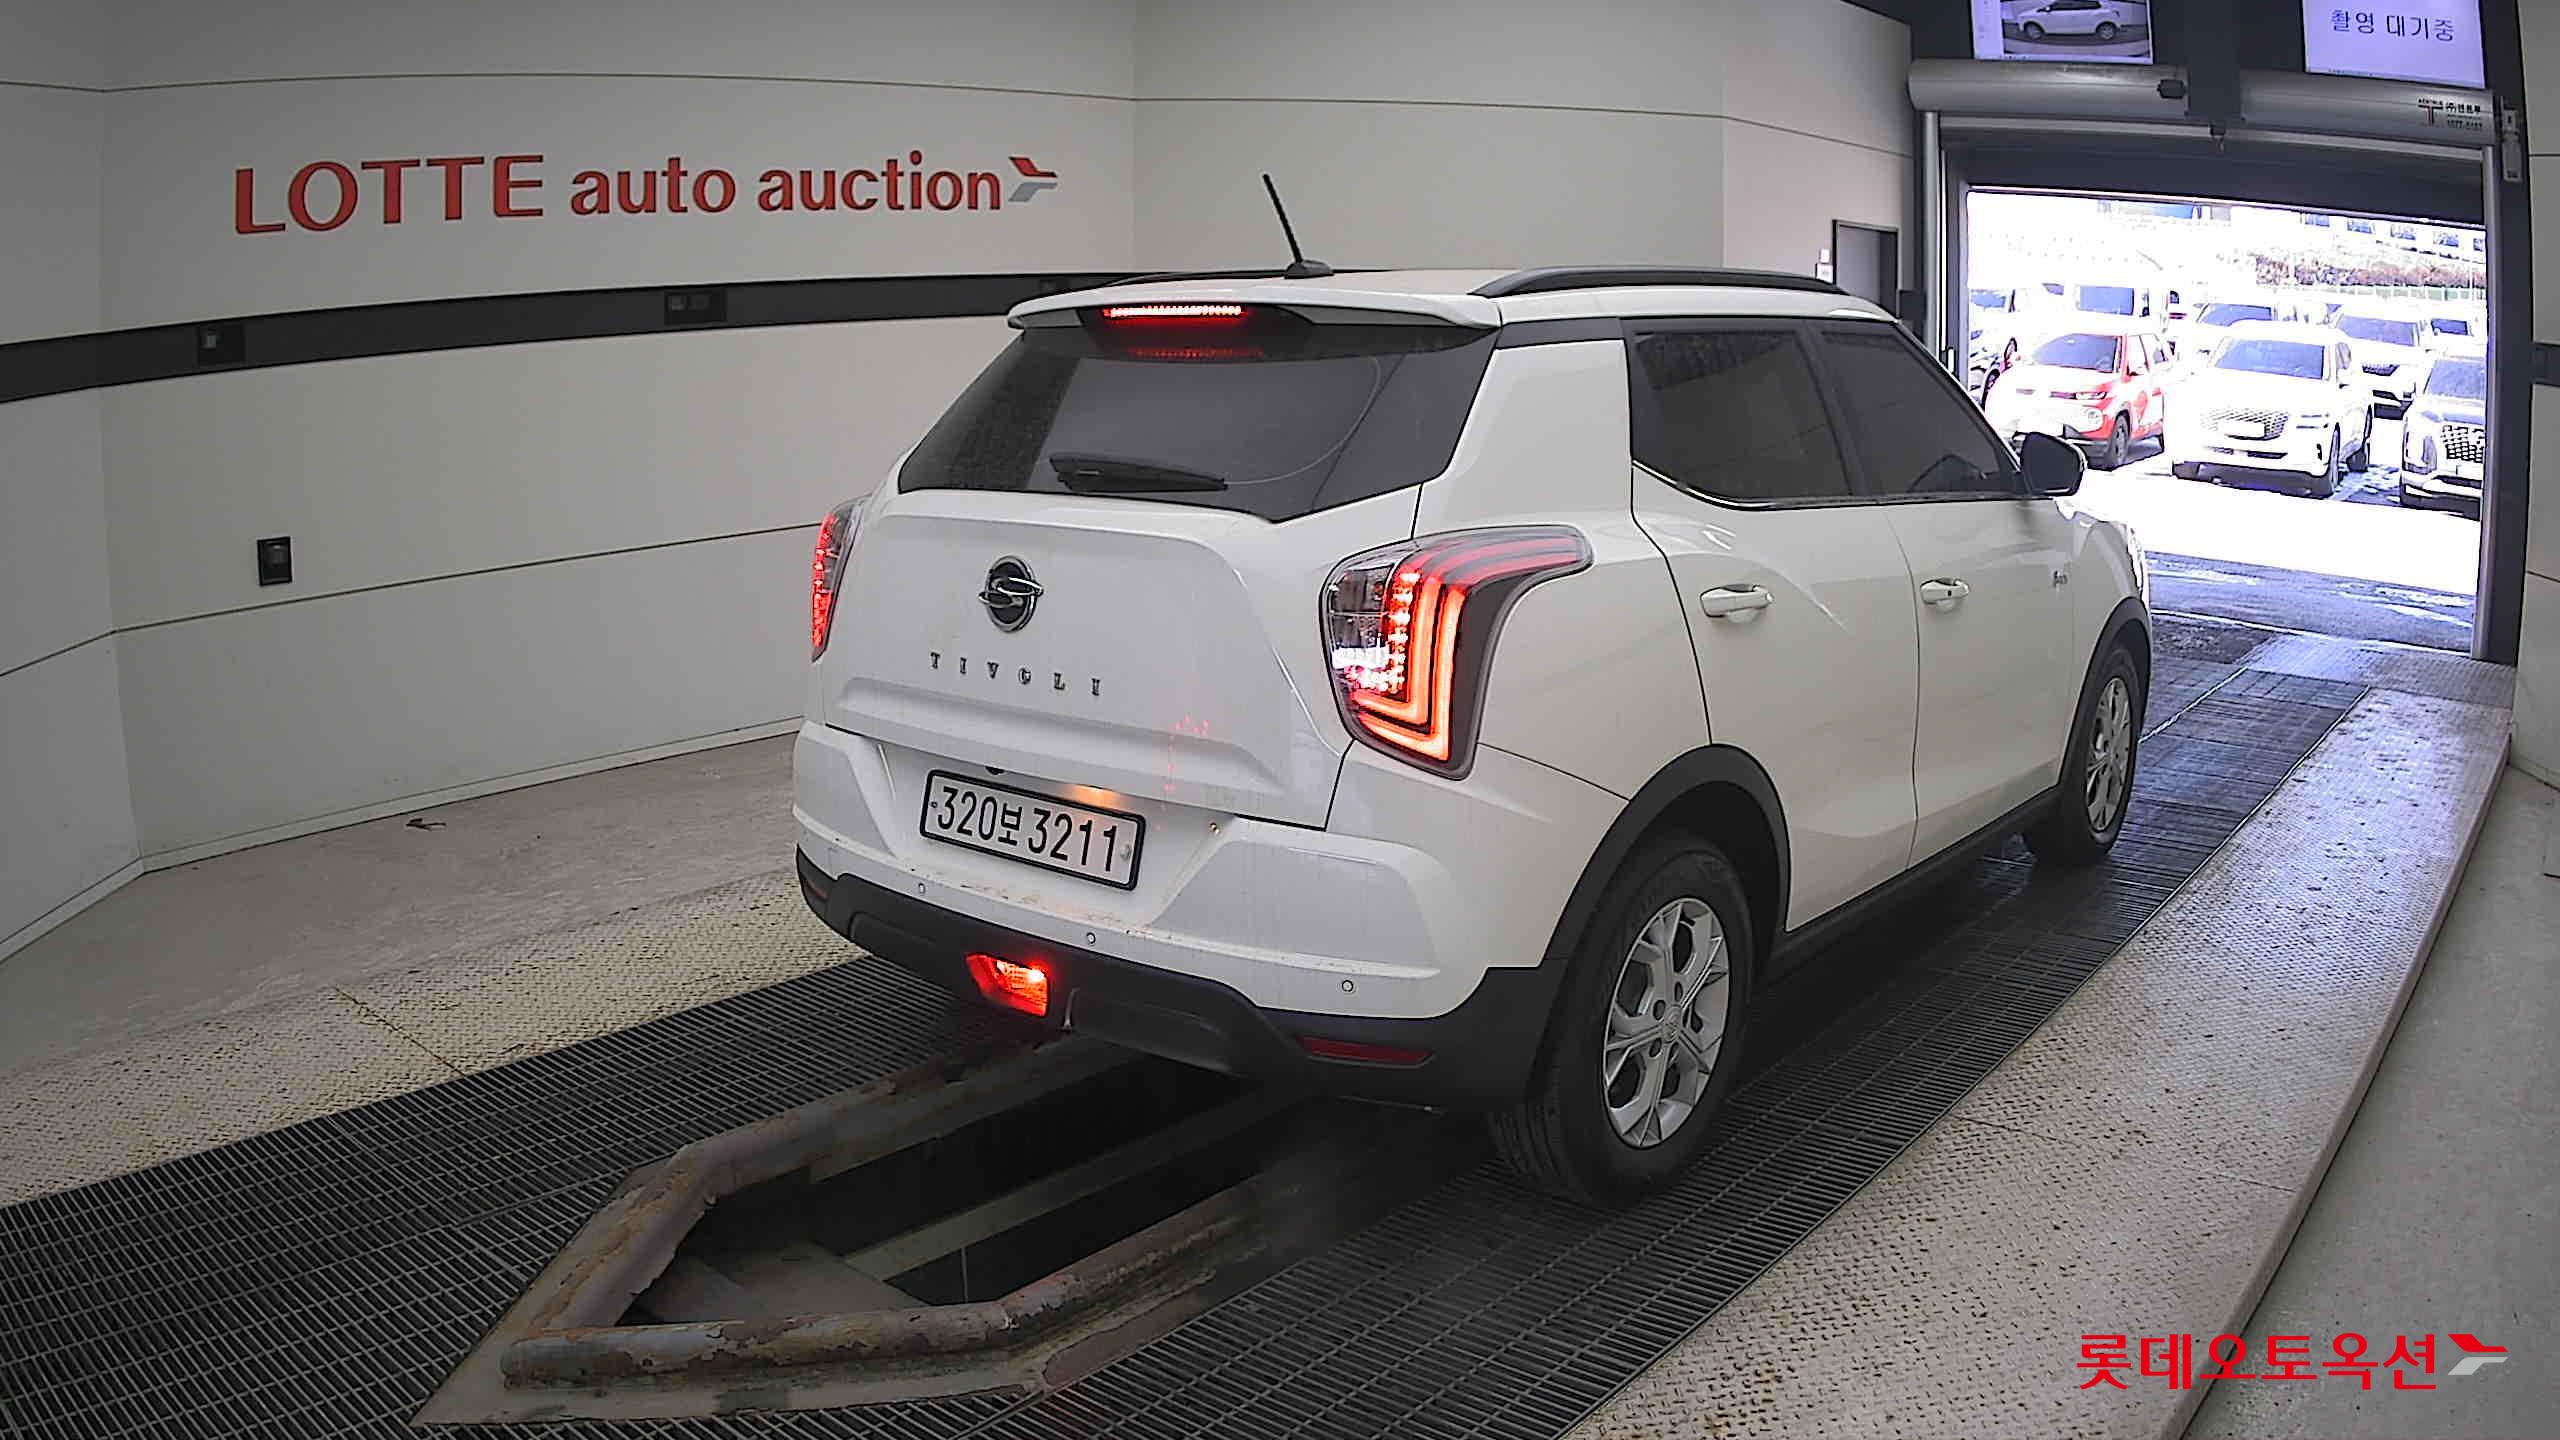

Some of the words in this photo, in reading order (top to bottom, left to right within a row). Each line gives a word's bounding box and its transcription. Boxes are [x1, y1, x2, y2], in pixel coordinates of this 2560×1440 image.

[2331, 9, 2375, 34] 촬영
[2386, 15, 2455, 42] 대기중
[235, 154, 544, 234] LOTTE
[572, 158, 737, 214] auto
[759, 151, 1002, 211] auction
[930, 651, 1102, 697] TIVOLI
